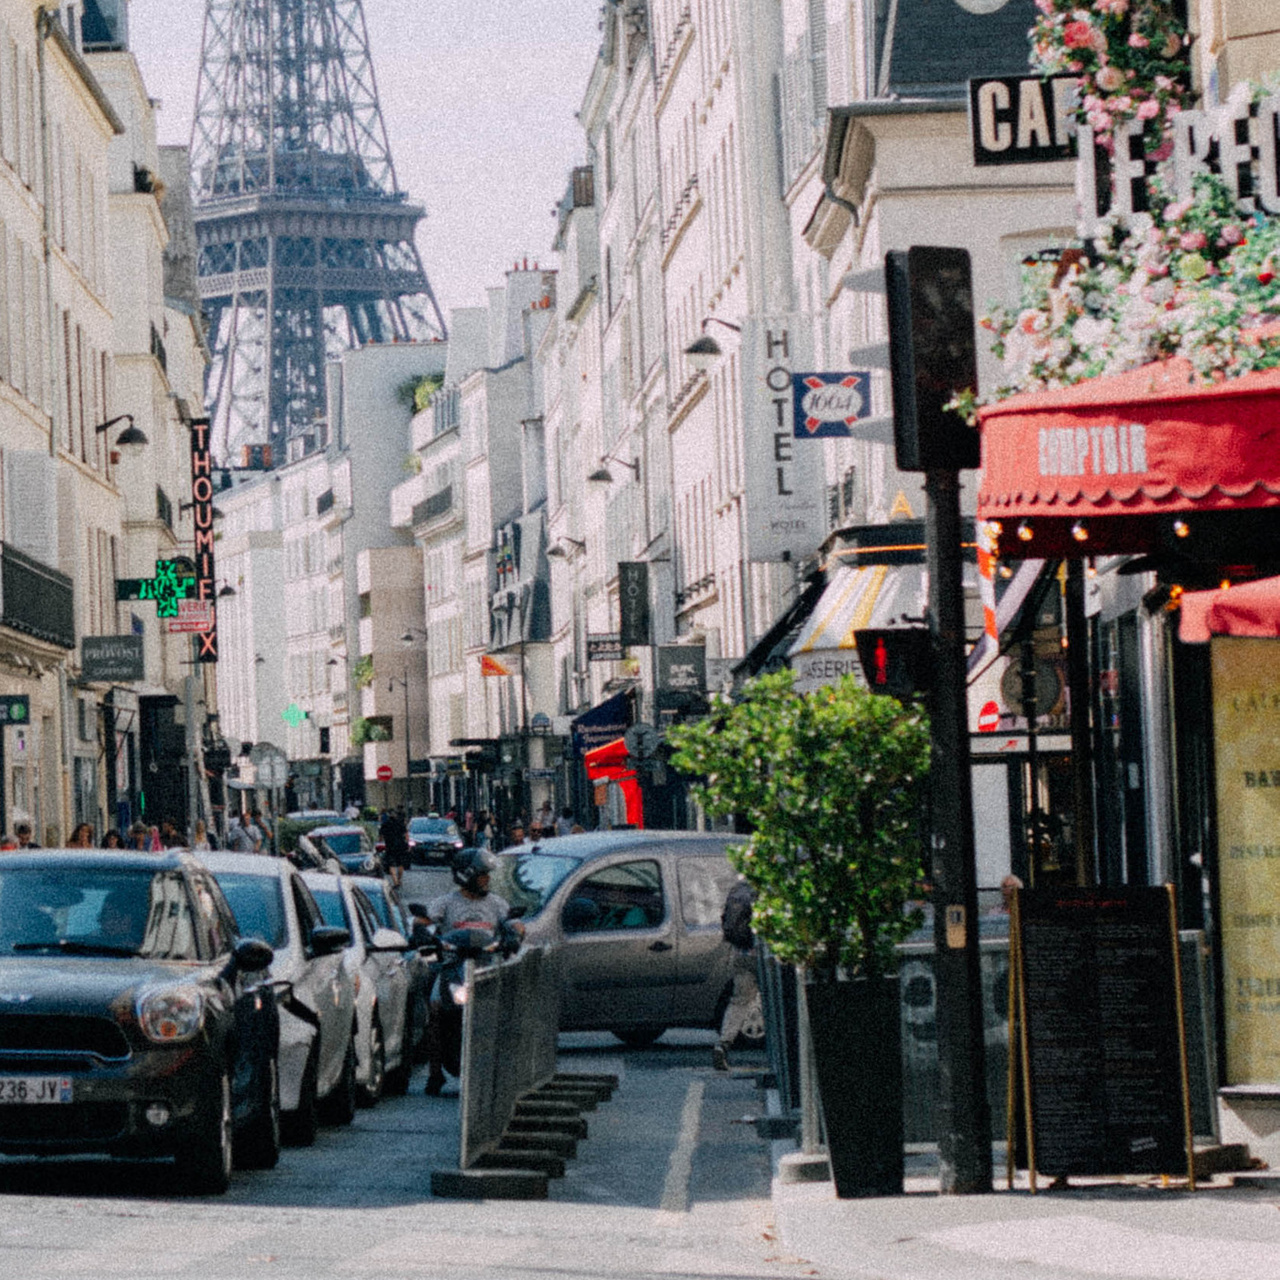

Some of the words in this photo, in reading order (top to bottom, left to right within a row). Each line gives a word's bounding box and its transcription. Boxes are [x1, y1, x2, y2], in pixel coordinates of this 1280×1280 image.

[978, 78, 1081, 152] CAF
[766, 329, 794, 497] HOTEL
[1038, 423, 1149, 476] COMPTOIR
[84, 646, 140, 660] PROVOST
